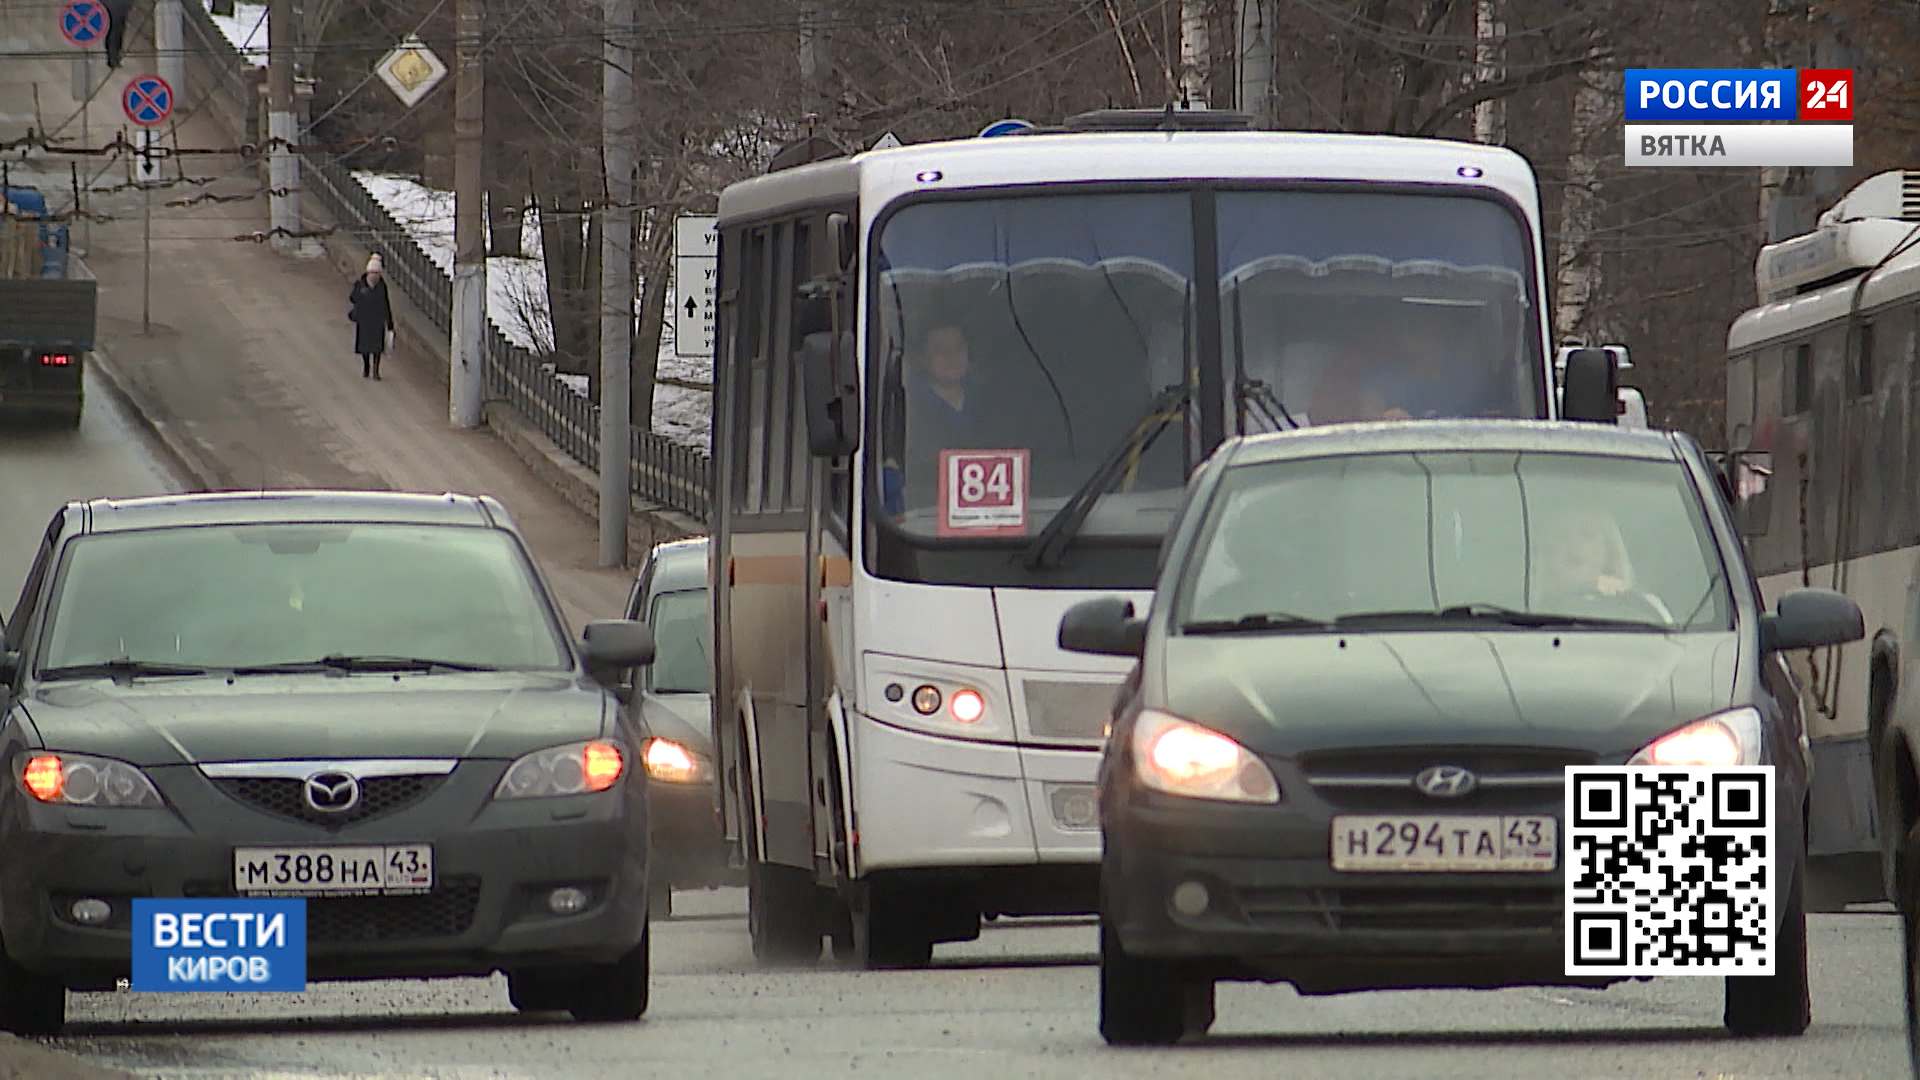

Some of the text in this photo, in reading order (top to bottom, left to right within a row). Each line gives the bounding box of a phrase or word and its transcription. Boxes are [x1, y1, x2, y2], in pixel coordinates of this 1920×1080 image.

[961, 463, 1011, 502] 84
[1508, 820, 1542, 846] 43
[390, 851, 419, 874] 43
